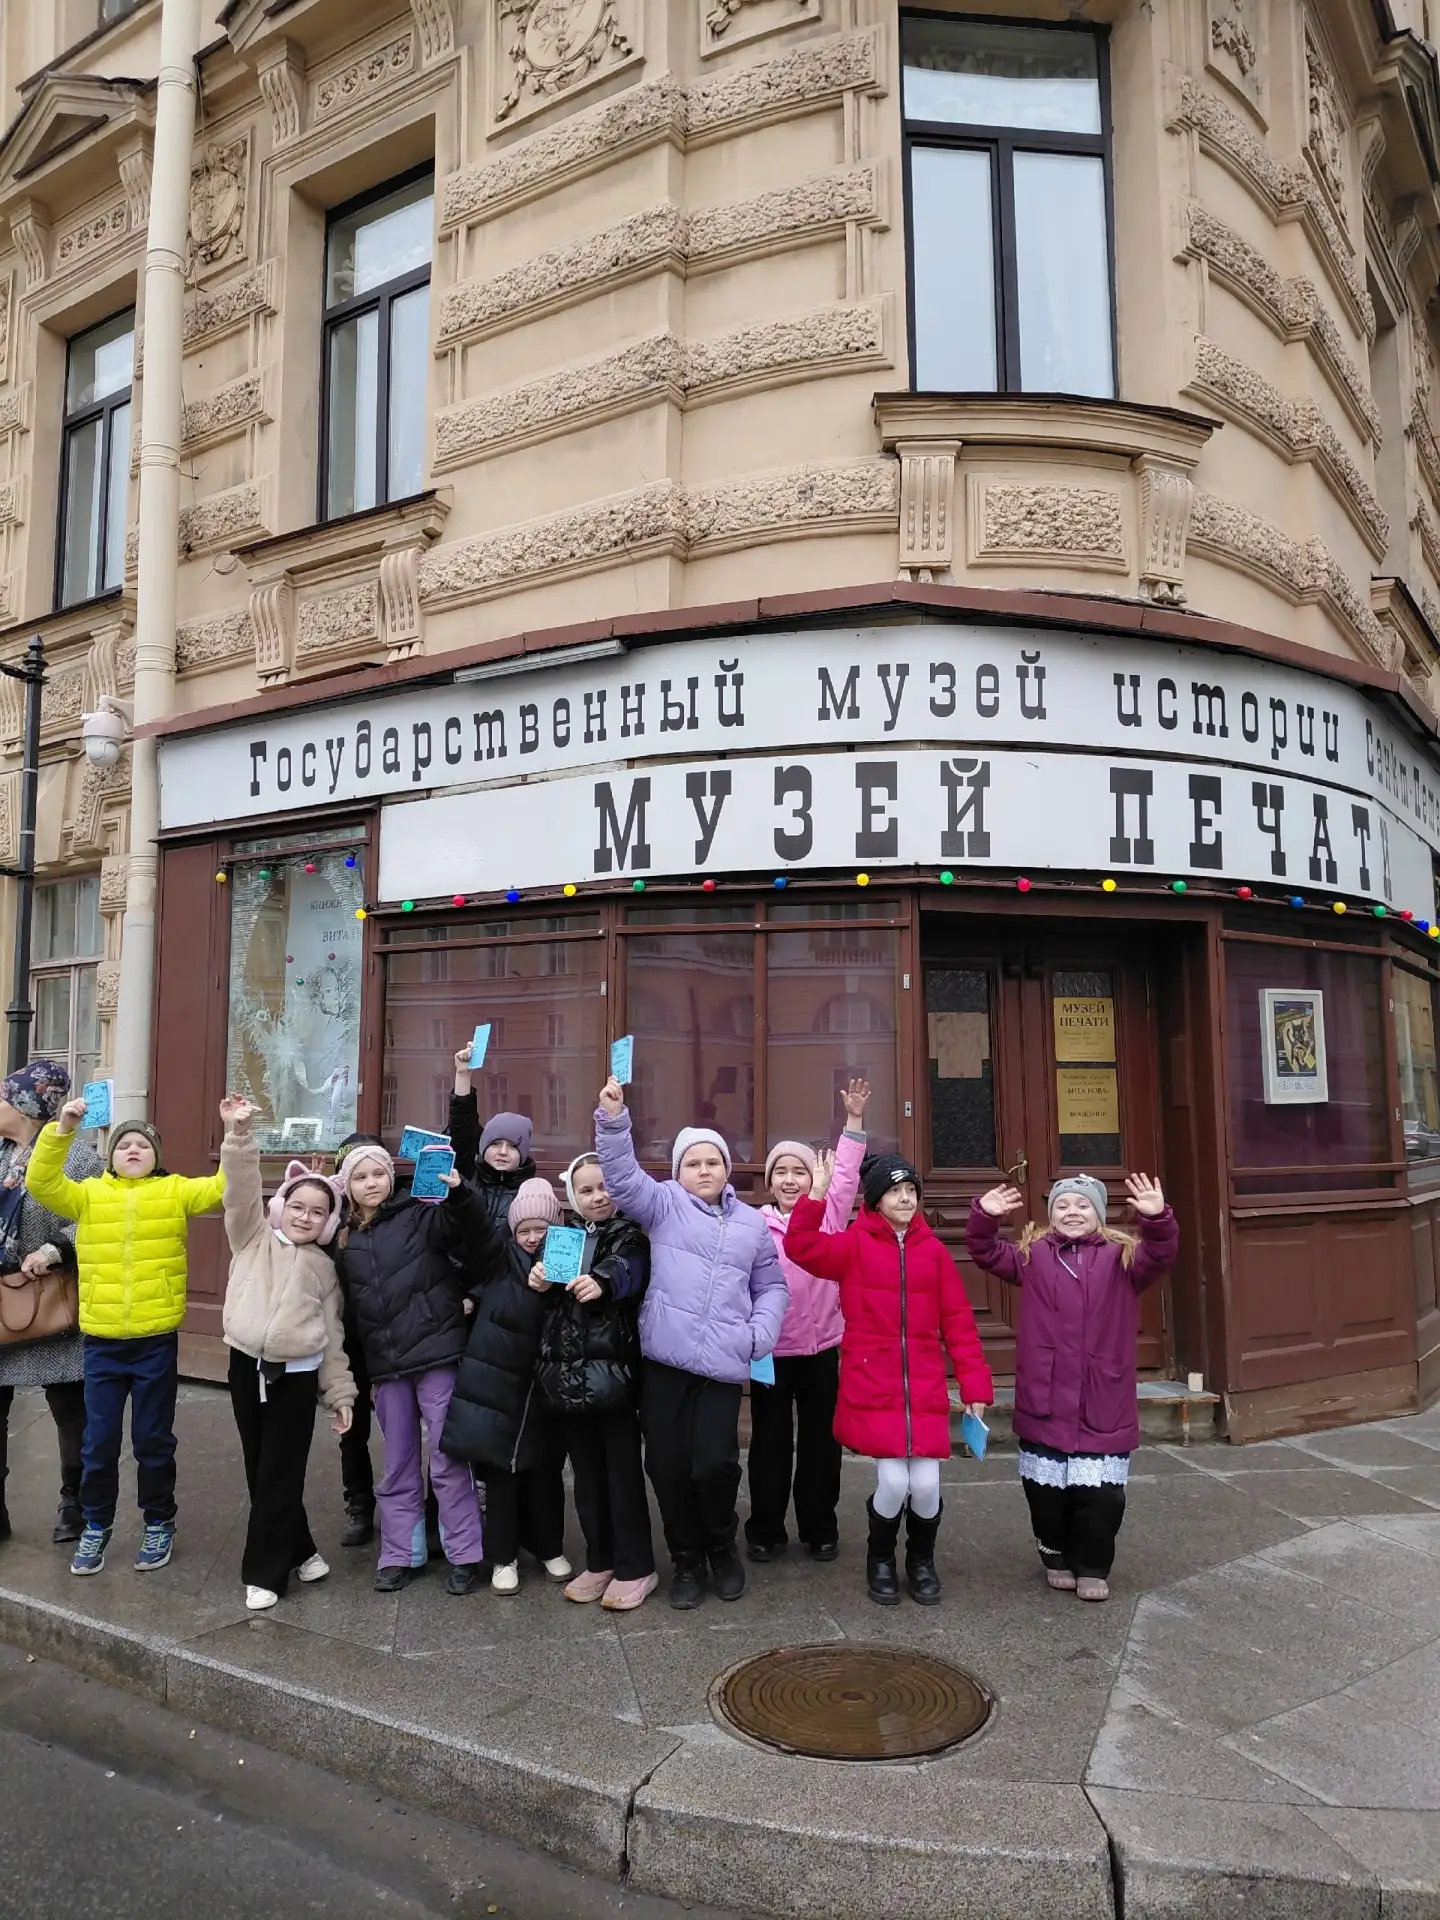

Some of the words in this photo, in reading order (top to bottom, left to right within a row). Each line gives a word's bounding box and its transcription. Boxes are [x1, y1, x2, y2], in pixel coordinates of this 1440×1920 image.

[250, 658, 744, 797] Государственный
[817, 650, 1047, 732] музей
[1113, 672, 1340, 763] истории
[593, 757, 991, 874] МУЗЕЙ
[1109, 767, 1393, 902] ПЕЧАТИ
[1060, 1017, 1109, 1027] ПЕЧАТИ
[1062, 1001, 1105, 1014] МУЗЕЙ
